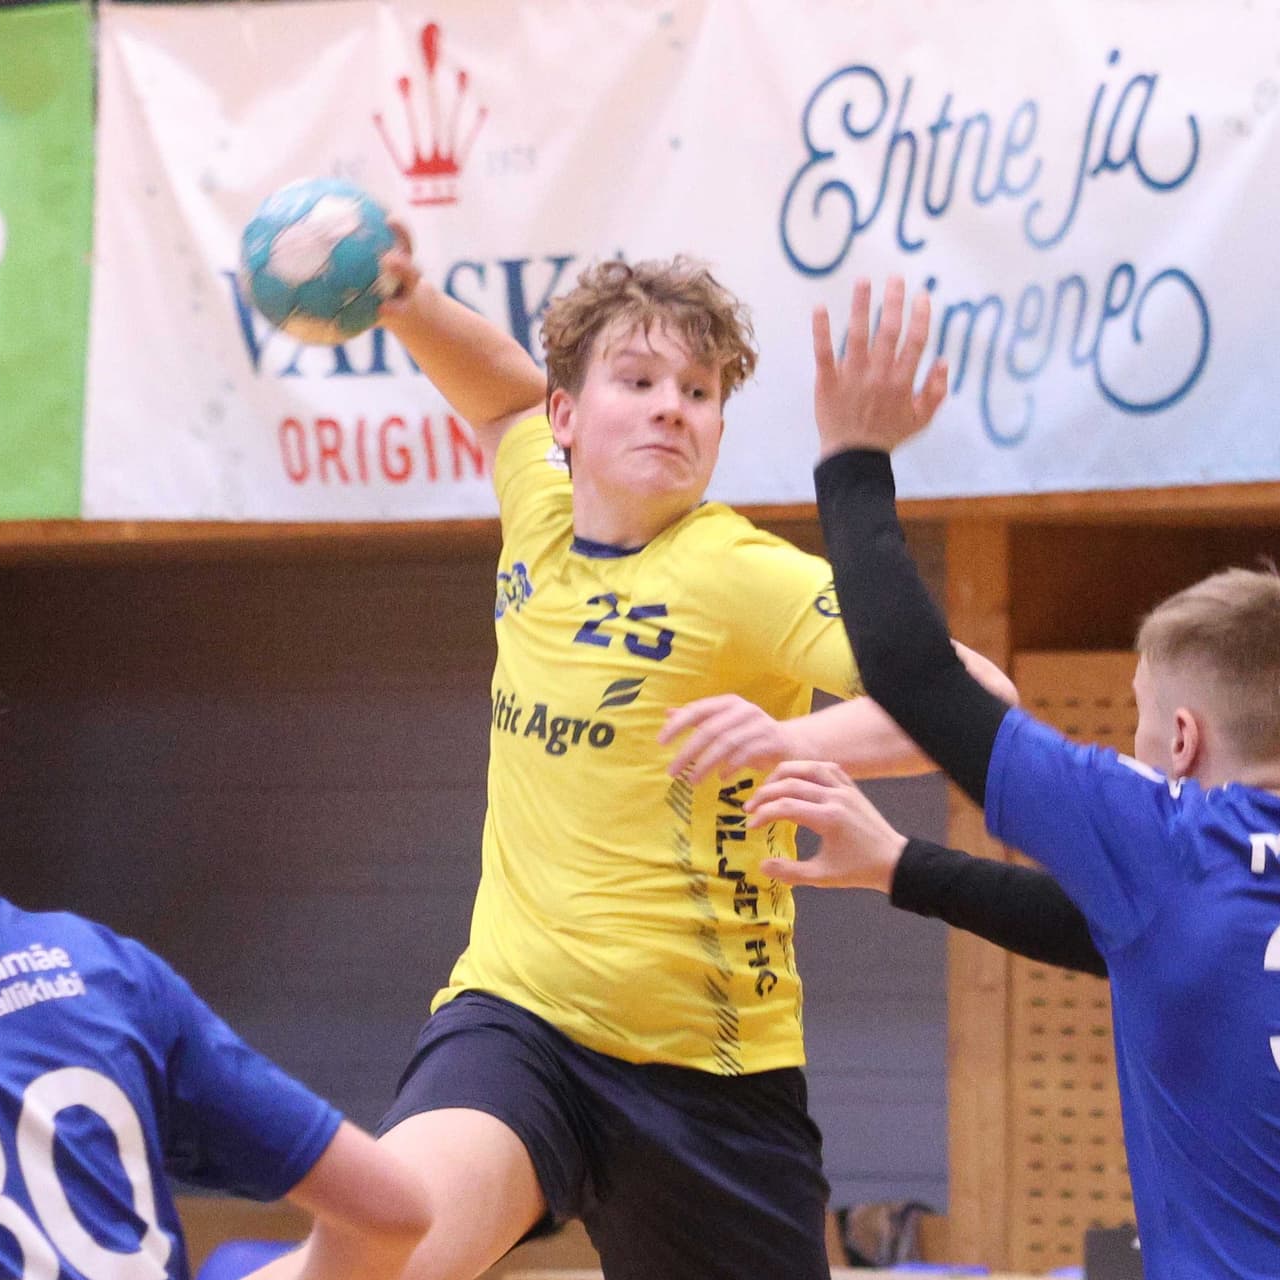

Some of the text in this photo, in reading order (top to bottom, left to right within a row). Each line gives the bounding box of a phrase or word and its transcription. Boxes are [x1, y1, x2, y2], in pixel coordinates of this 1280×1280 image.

[779, 49, 1201, 277] Ehtne ja
[573, 591, 677, 662] 25
[523, 702, 617, 757] Agro
